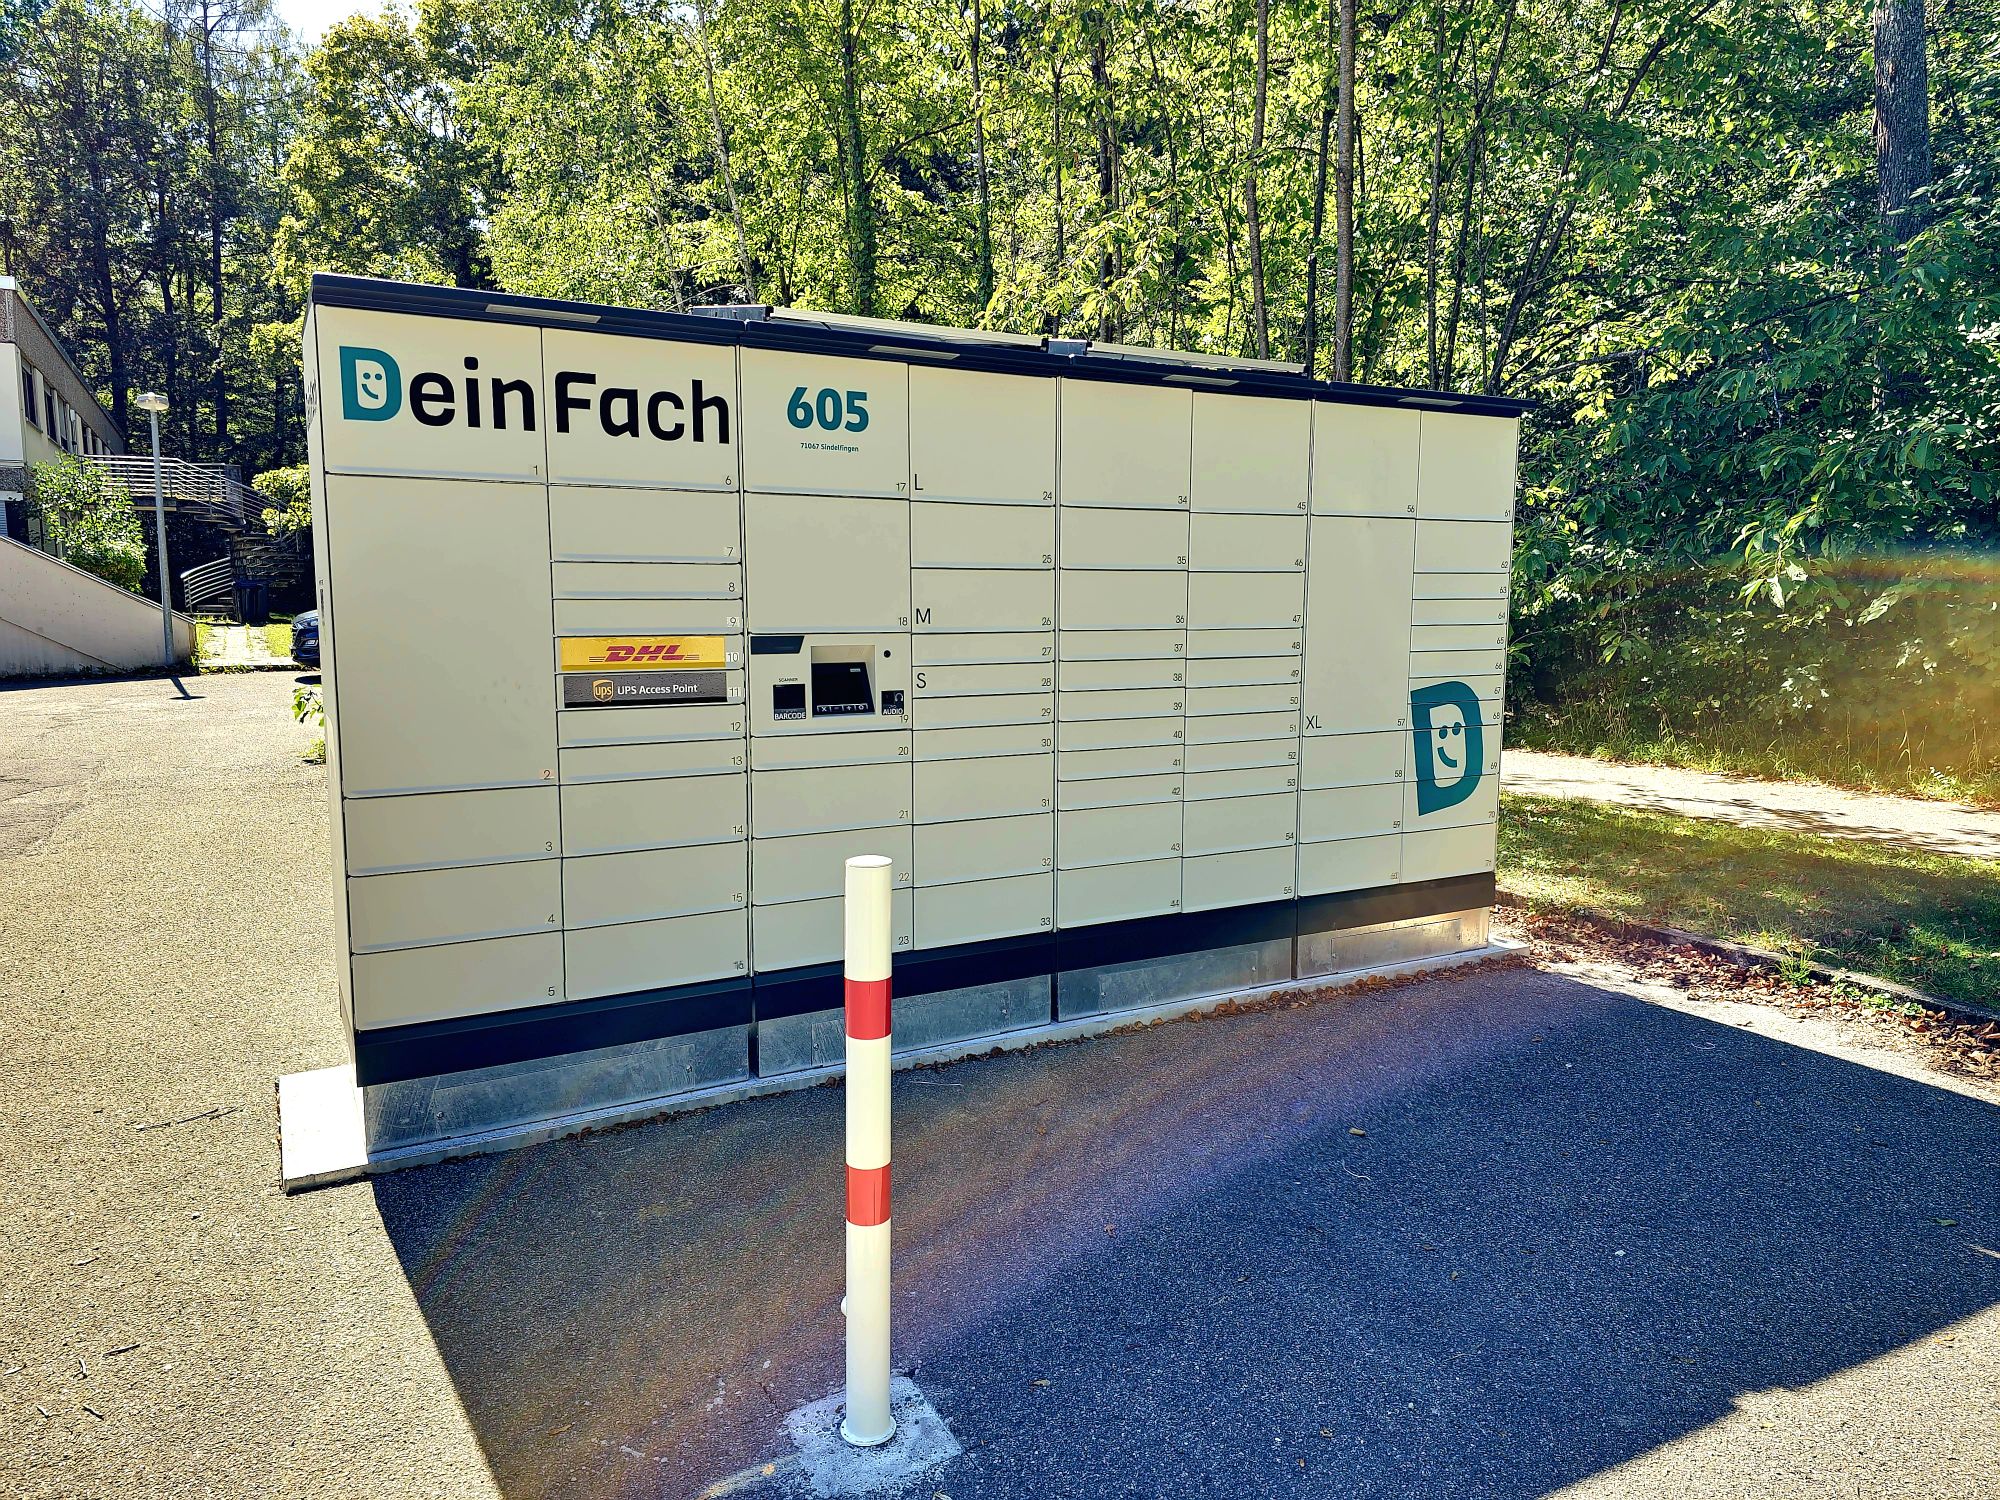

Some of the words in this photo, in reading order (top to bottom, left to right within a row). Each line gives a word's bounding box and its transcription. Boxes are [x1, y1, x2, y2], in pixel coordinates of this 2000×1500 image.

[787, 386, 869, 432] 605
[820, 443, 859, 453] Sindelfingen
[533, 465, 539, 476] 1
[725, 475, 732, 486] 6
[915, 474, 923, 491] L
[895, 482, 906, 492] 17
[1042, 491, 1053, 501] 24
[1178, 496, 1188, 505] 34
[1297, 502, 1306, 510] 45
[1407, 505, 1415, 513] 56
[727, 547, 734, 557] 7
[1042, 554, 1052, 564] 25
[1177, 556, 1187, 565] 35
[1295, 559, 1303, 567] 46
[1501, 561, 1508, 569] 62
[728, 582, 736, 593] 8
[1500, 586, 1507, 594] 63
[916, 608, 931, 624] M
[1175, 615, 1185, 624] 36
[1292, 615, 1301, 624] 47
[729, 616, 737, 628] 9
[898, 617, 908, 626] 18
[1041, 617, 1052, 627] 26
[1292, 641, 1300, 650] 48
[1496, 637, 1504, 645] 65
[1041, 647, 1052, 657] 27
[1174, 644, 1183, 652] 37
[604, 645, 686, 662] DHL
[727, 651, 740, 663] 10
[1495, 662, 1502, 670] 66
[1173, 673, 1182, 682] 38
[1291, 670, 1299, 678] 49
[916, 672, 926, 688] S
[1041, 678, 1052, 688] 28
[594, 687, 613, 698] ups
[617, 685, 637, 695] UPS
[639, 685, 671, 694] Access
[673, 684, 698, 693] Point
[729, 686, 741, 698] 11
[1173, 702, 1183, 711] 39
[774, 711, 806, 720] BARCODE
[1041, 708, 1051, 718] 29
[1492, 711, 1500, 720] 68
[900, 714, 909, 723] 19
[1306, 715, 1322, 729] XL
[1397, 718, 1405, 727] 57
[730, 721, 741, 733] 12
[1289, 724, 1297, 733] 51
[1173, 731, 1183, 739] 40
[1041, 738, 1052, 748] 30
[898, 746, 909, 756] 20
[1288, 752, 1296, 760] 52
[731, 756, 743, 766] 13
[1173, 759, 1181, 767] 41
[1490, 762, 1497, 770] 69
[543, 769, 551, 780] 2
[1394, 770, 1403, 778] 58
[1287, 779, 1295, 787] 53
[1172, 787, 1180, 796] 42
[1041, 798, 1050, 808] 31
[899, 810, 909, 819] 21
[732, 825, 744, 835] 14
[1285, 833, 1294, 841] 54
[545, 841, 553, 851] 3
[1171, 843, 1180, 852] 43
[1041, 857, 1052, 867] 32
[899, 872, 910, 882] 22
[1283, 887, 1292, 895] 55
[732, 893, 743, 903] 15
[547, 914, 555, 923] 4
[1040, 917, 1051, 927] 33
[898, 936, 910, 946] 23
[547, 986, 555, 997] 5
